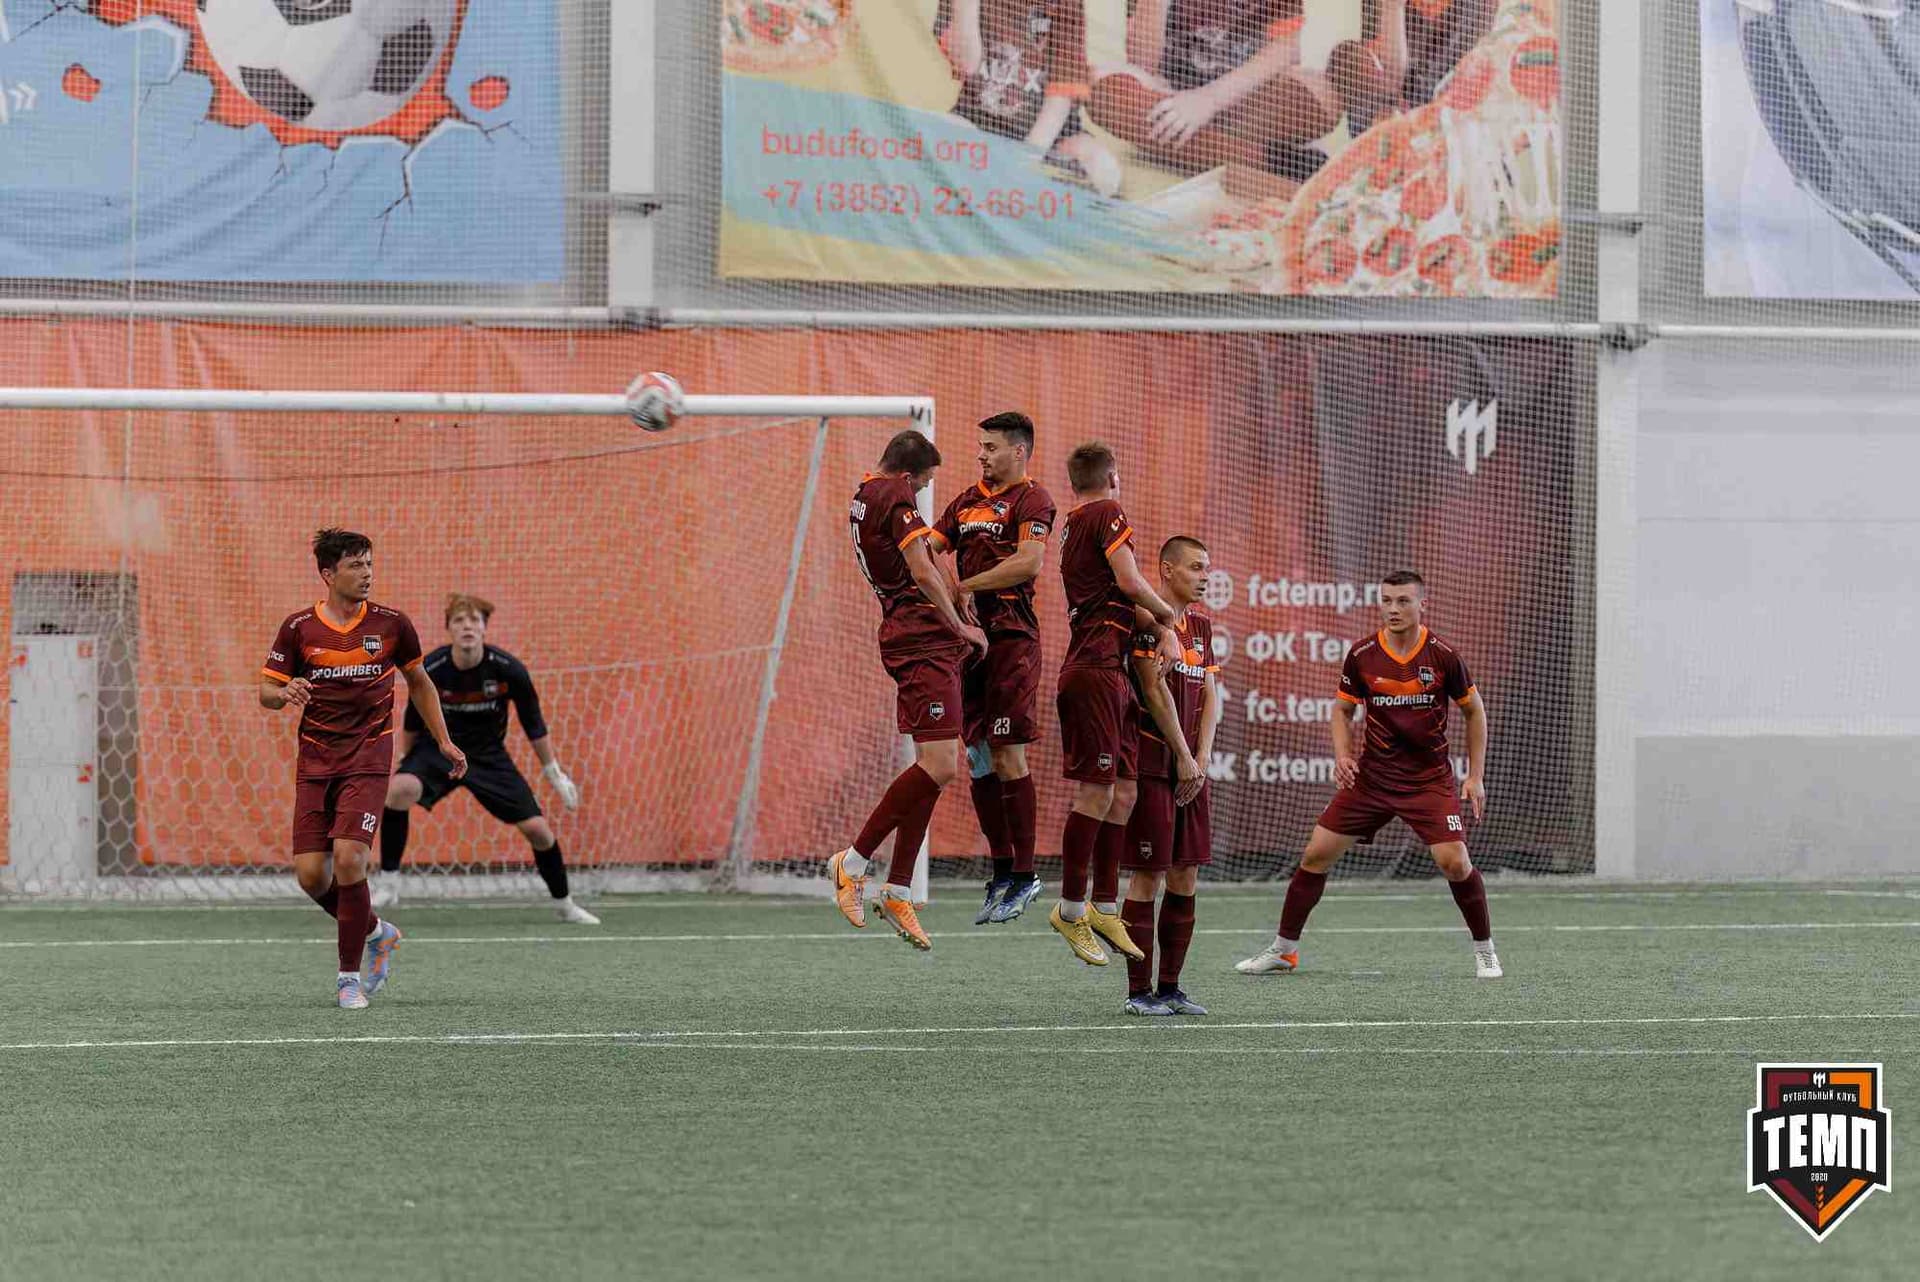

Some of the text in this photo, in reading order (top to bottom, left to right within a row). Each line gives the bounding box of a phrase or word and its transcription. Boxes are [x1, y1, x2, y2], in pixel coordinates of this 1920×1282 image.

[761, 181, 1075, 222] +7 (3852) 22-66-01
[1246, 630, 1297, 662] ФК
[994, 717, 1010, 735] 23
[362, 812, 376, 833] 22
